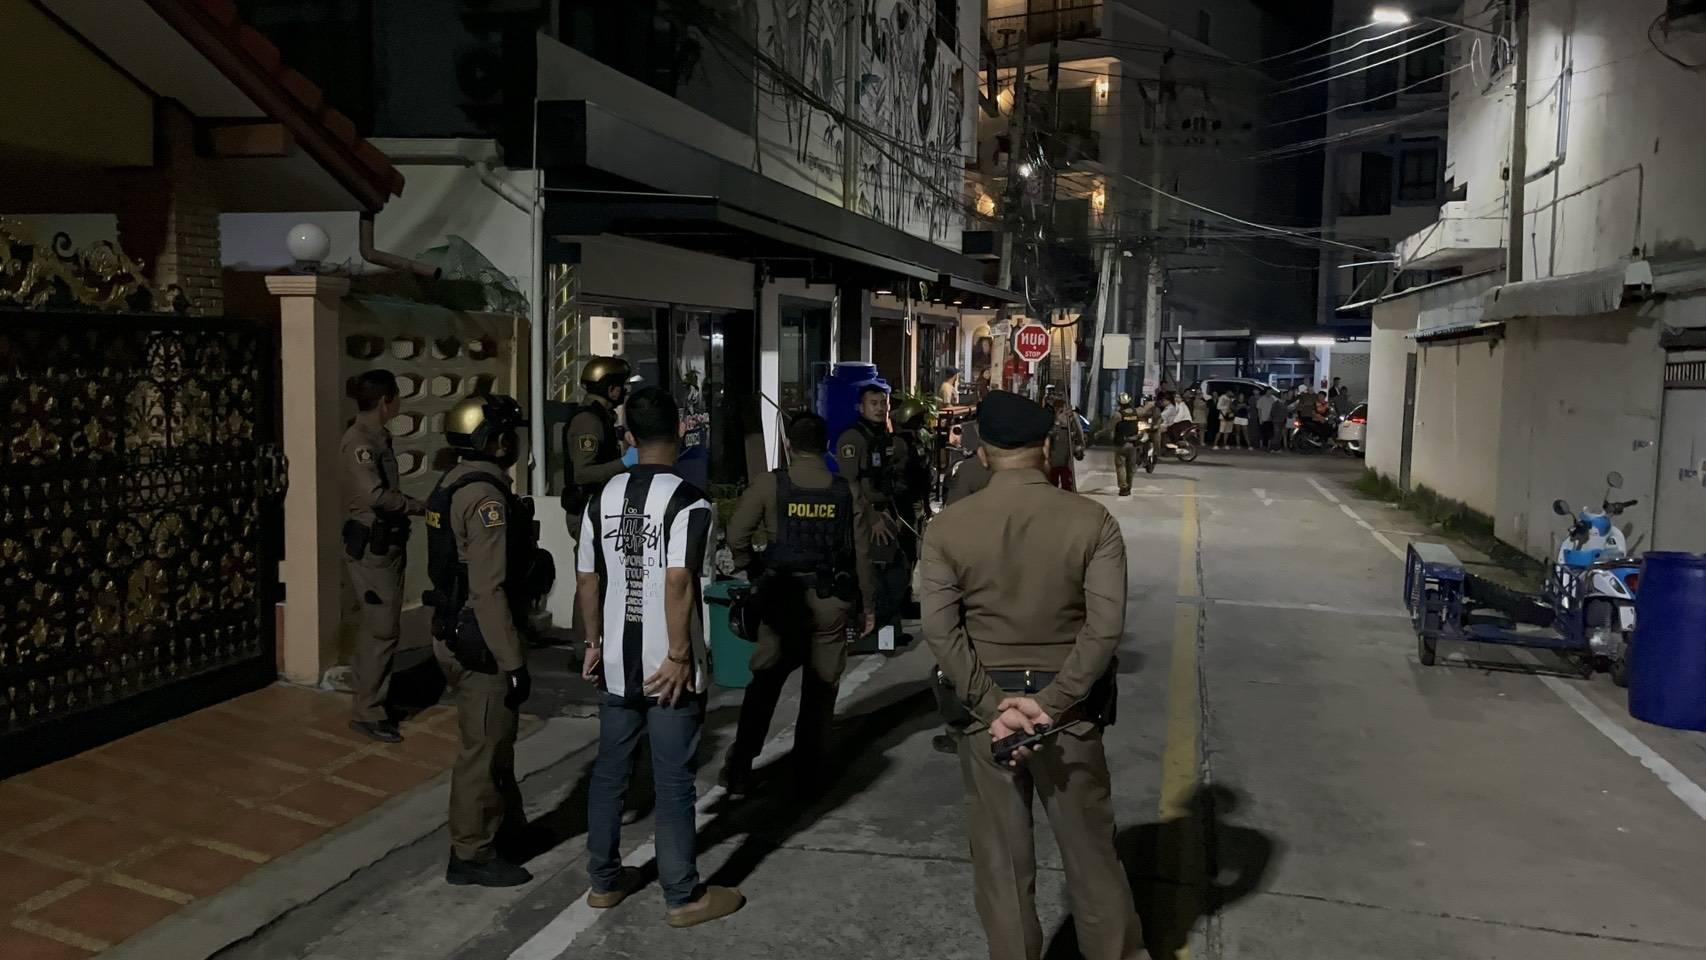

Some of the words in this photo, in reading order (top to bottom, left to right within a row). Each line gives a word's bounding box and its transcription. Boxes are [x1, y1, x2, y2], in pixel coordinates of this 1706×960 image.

[1021, 332, 1046, 350] หยุด
[788, 503, 836, 518] POLICE
[619, 555, 655, 567] WORLD
[625, 568, 650, 580] TOUR
